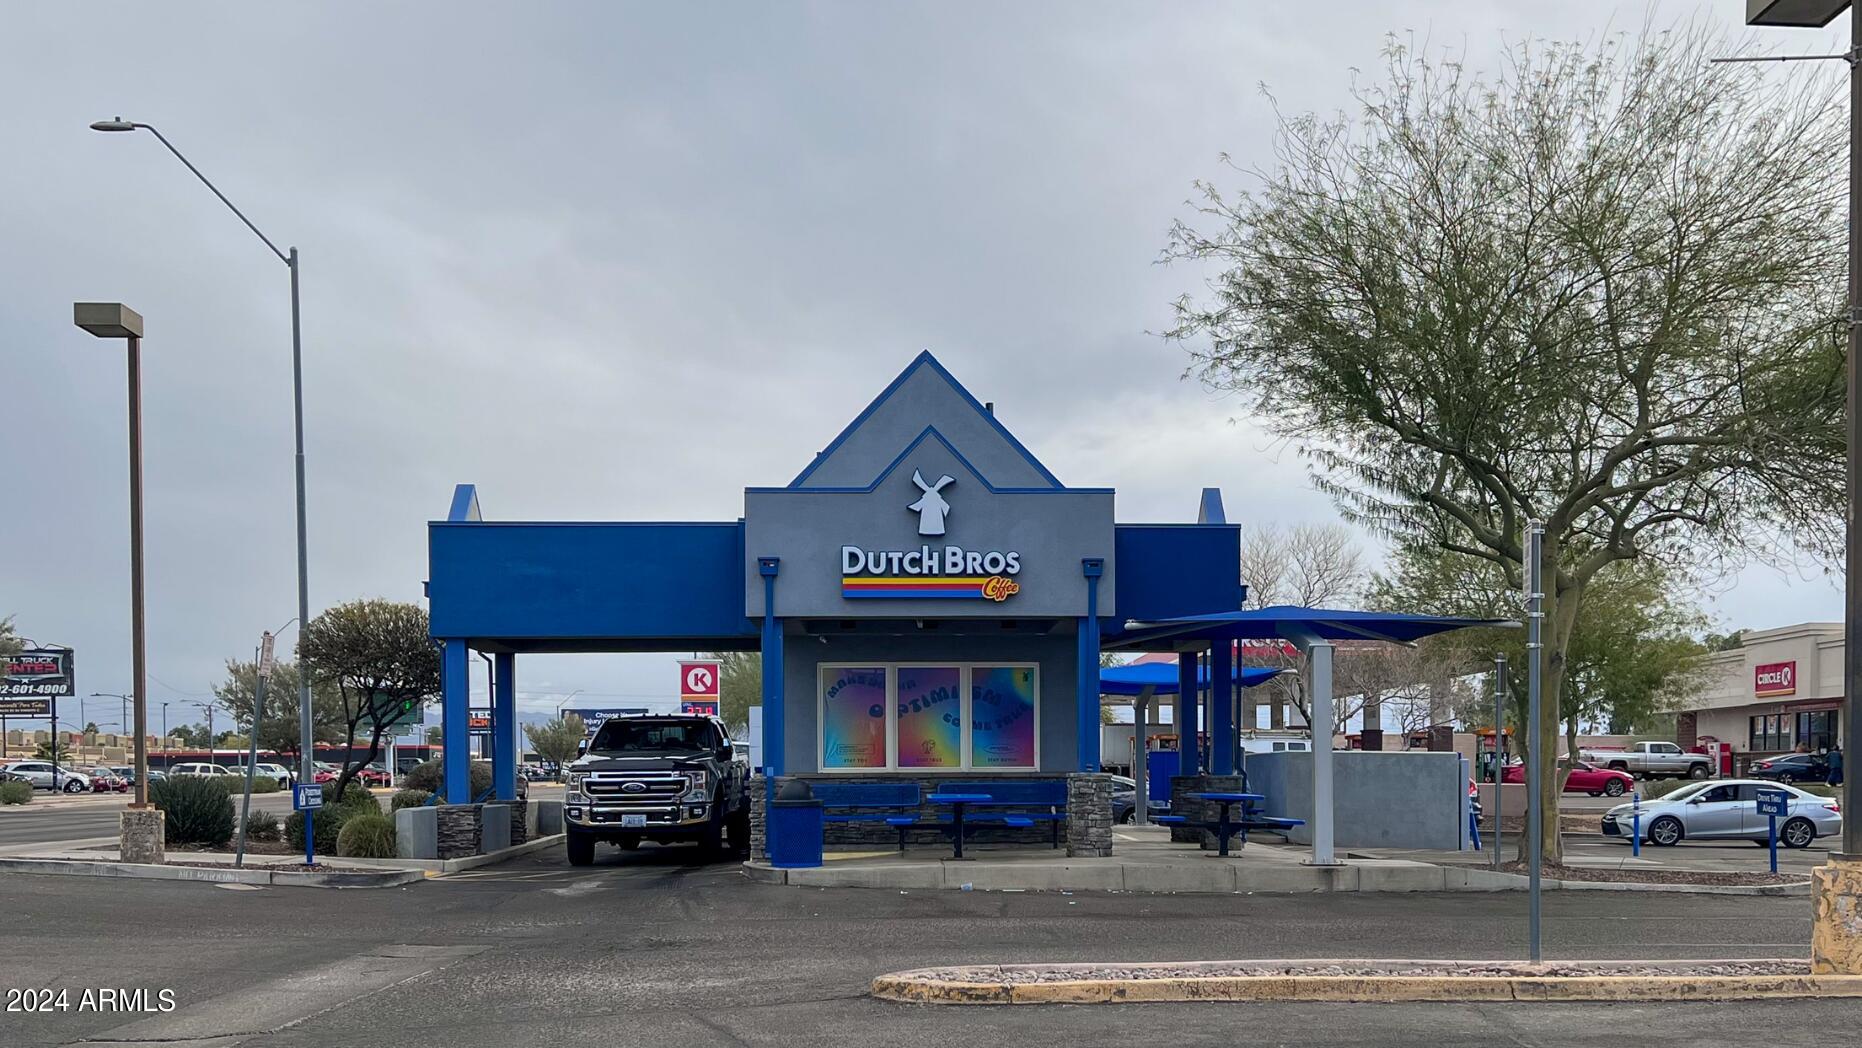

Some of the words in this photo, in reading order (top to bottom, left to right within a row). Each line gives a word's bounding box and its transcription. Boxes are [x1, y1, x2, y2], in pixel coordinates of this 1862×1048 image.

[842, 545, 939, 574] DUTCH
[945, 546, 1021, 574] BROS
[982, 576, 1020, 601] Coffee
[1757, 672, 1781, 684] CIRCLE
[0, 684, 67, 694] 2-601-4900
[584, 717, 602, 725] Injury
